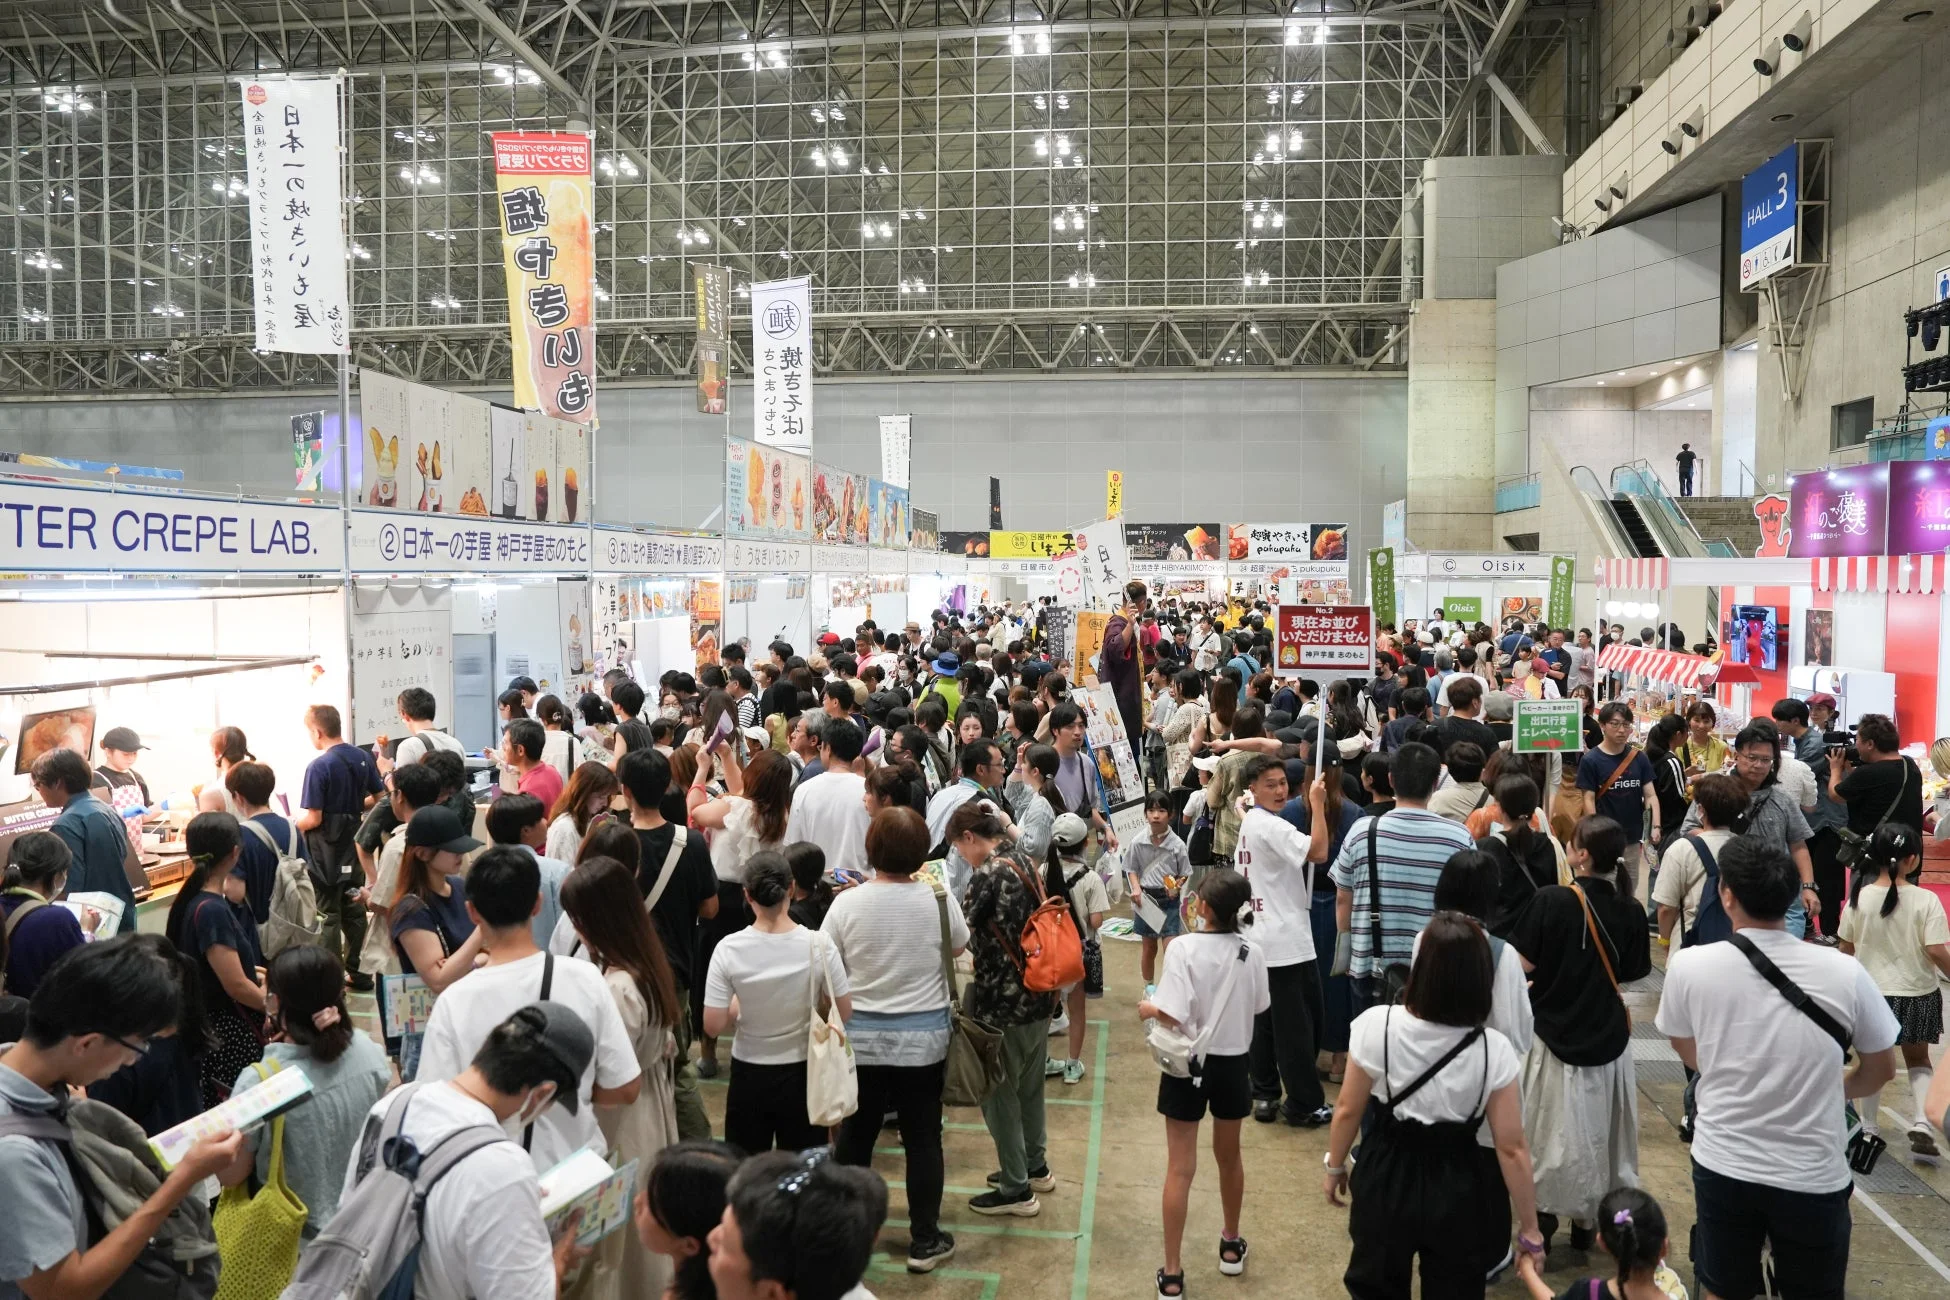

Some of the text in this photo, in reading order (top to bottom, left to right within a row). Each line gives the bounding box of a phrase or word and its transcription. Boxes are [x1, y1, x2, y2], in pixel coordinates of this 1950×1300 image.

[1747, 171, 1788, 229] HALL 3
[0, 503, 318, 555] TER CREPE LAB.
[496, 532, 587, 563] 神戸芋屋志のもと
[1300, 565, 1341, 574] pukupuku
[1482, 560, 1525, 572] Oisix
[1449, 603, 1476, 613] Oisix
[1291, 615, 1359, 630] 現在お並び
[1281, 630, 1369, 644] いただけません
[1305, 651, 1365, 659] 神戸芋屋 志のもと
[1530, 716, 1568, 725] 出口行き
[1521, 727, 1577, 737] エレベーター
